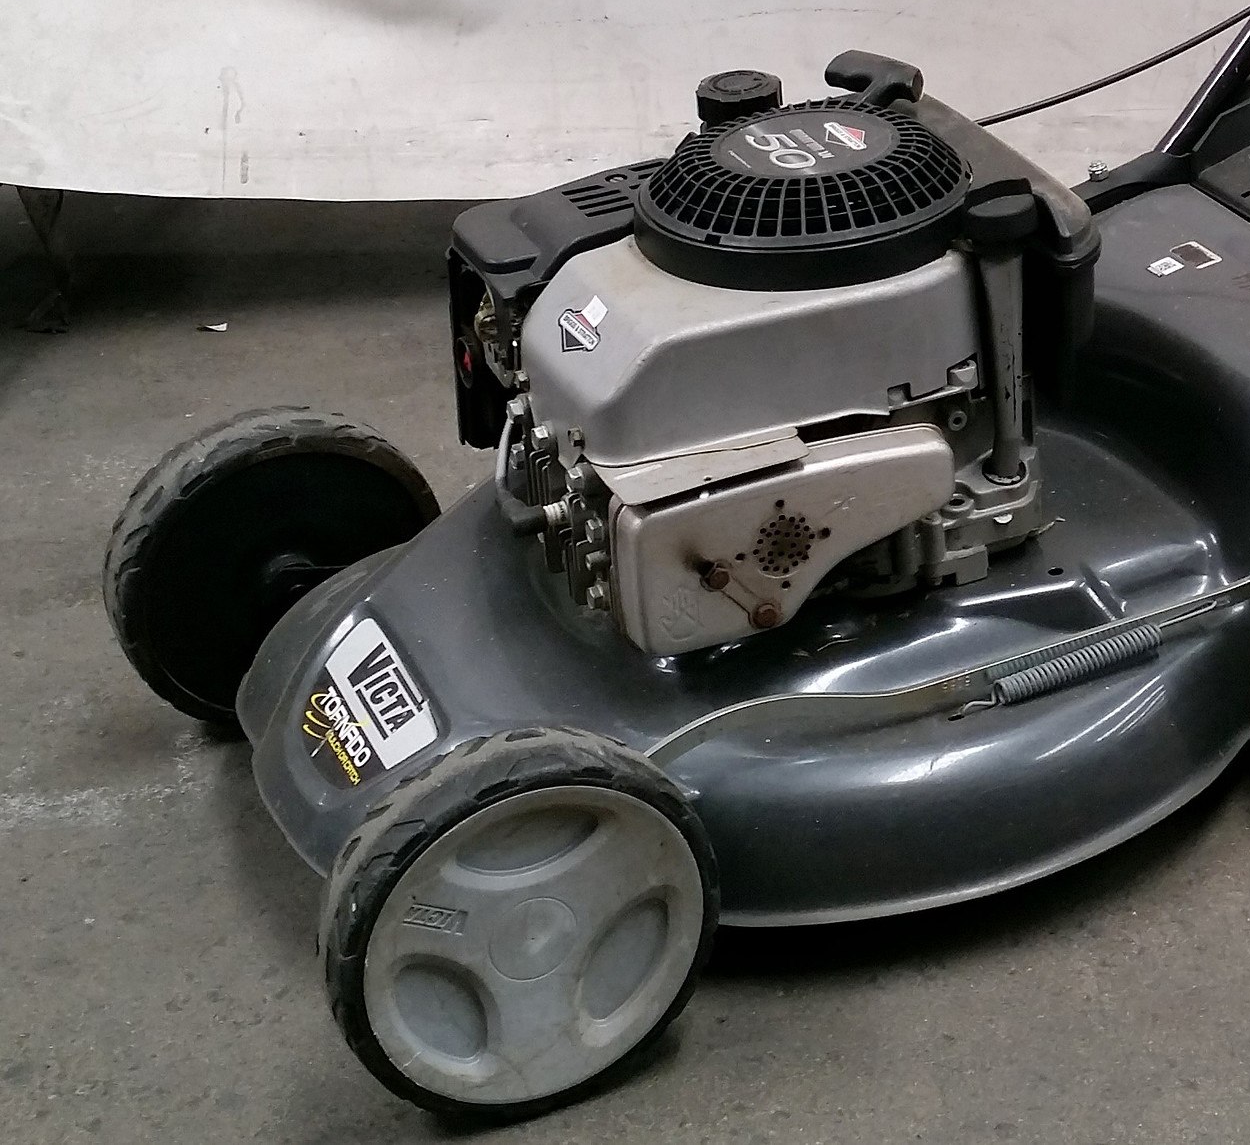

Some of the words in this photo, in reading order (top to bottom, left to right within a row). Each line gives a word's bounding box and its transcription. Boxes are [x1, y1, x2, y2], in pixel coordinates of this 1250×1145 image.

[744, 133, 816, 169] 50
[320, 686, 372, 767] TORNADO
[347, 642, 416, 733] VICTA
